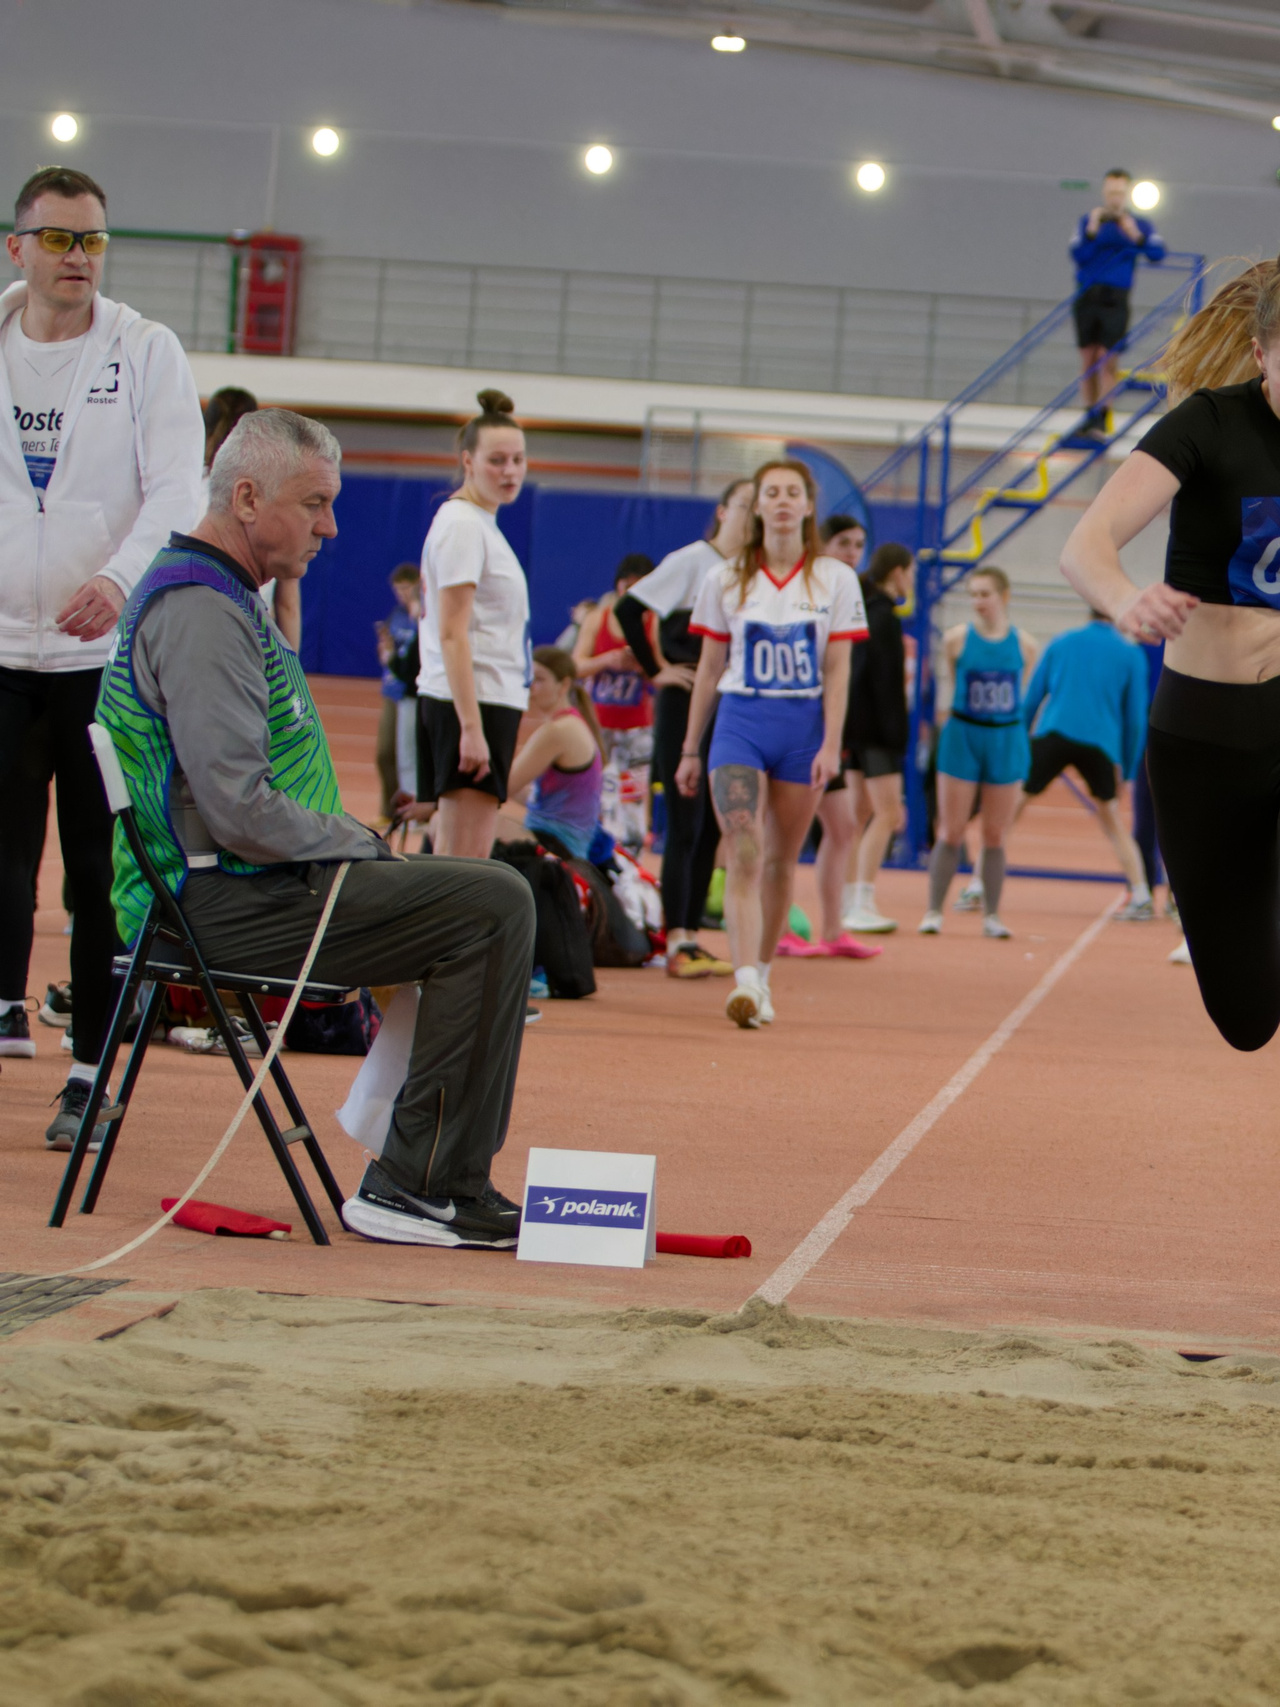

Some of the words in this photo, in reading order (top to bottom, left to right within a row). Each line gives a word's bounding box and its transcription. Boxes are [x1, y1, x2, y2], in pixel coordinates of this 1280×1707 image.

[753, 639, 813, 683] 005
[969, 681, 1015, 713] 030
[560, 1199, 638, 1218] polanik
